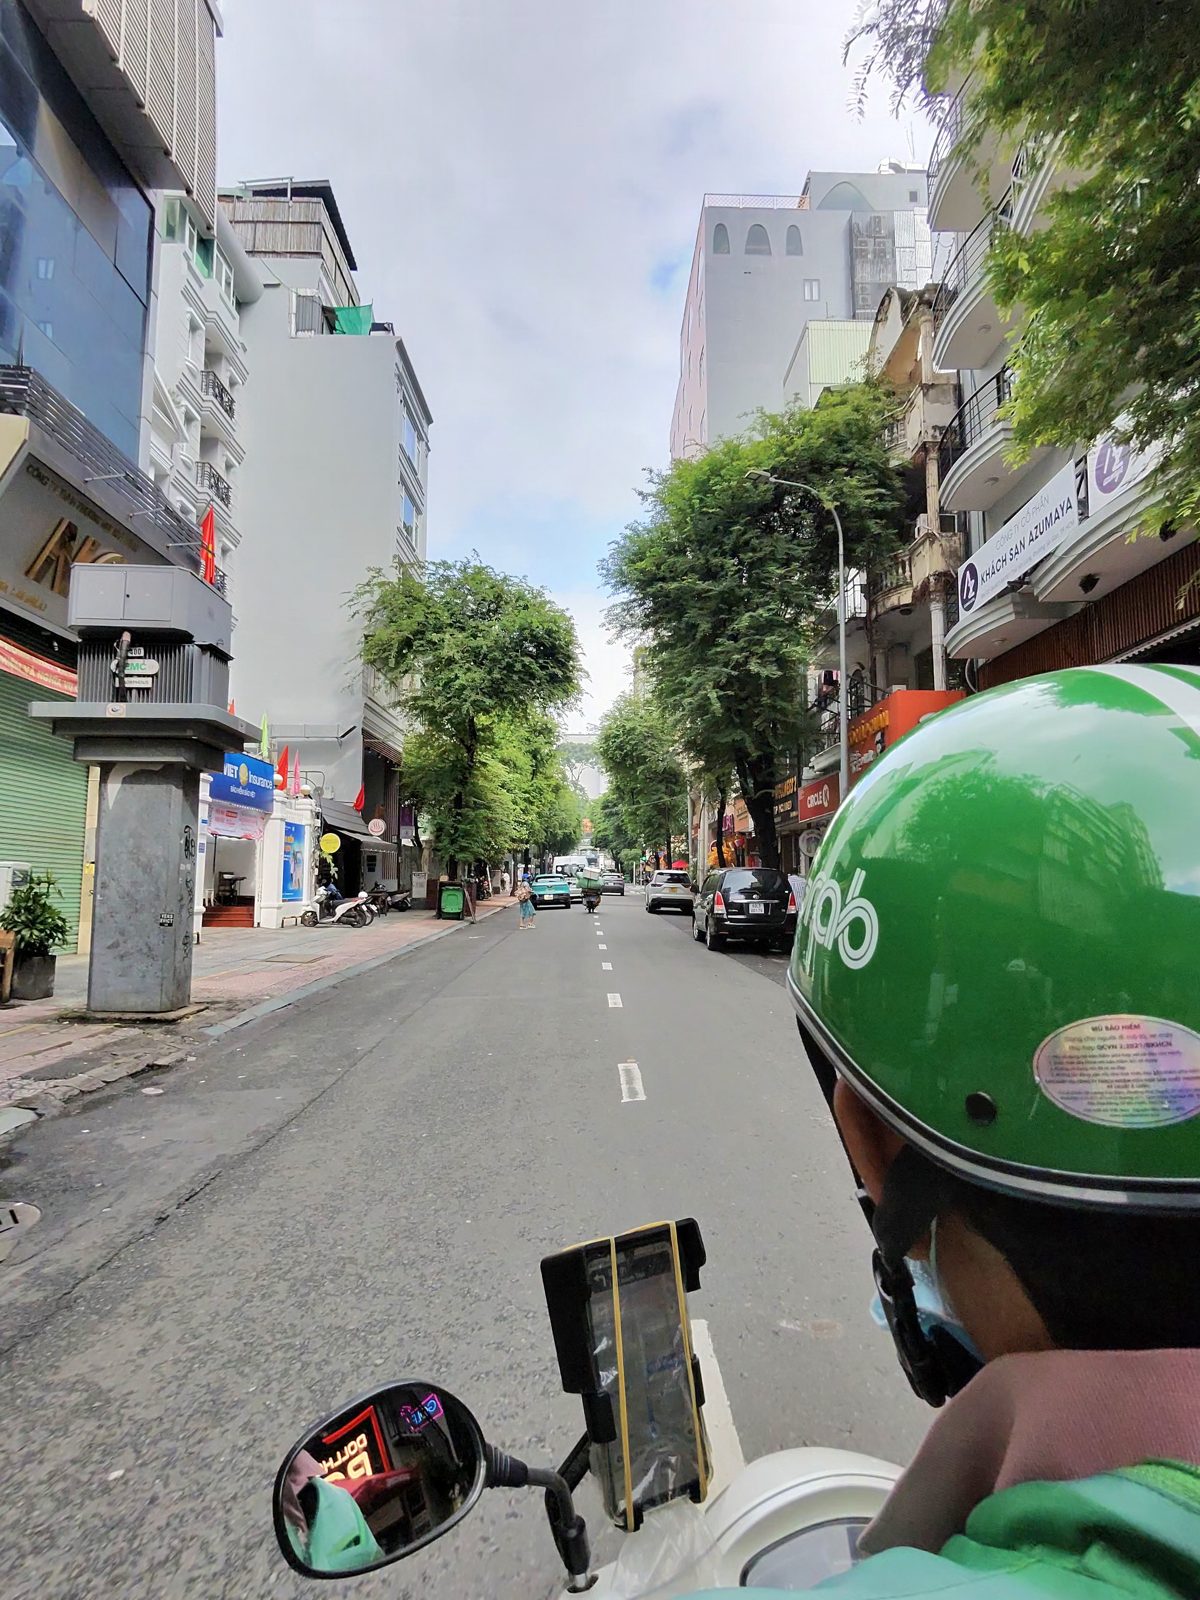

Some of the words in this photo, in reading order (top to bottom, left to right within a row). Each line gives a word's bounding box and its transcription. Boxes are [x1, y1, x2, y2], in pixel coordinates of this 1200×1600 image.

[980, 554, 1007, 585] KHÁCH
[1009, 540, 1026, 562] SẠN
[1028, 496, 1073, 546] AZUMAYA
[249, 770, 273, 790] Insurance
[807, 791, 823, 809] CIRCLE
